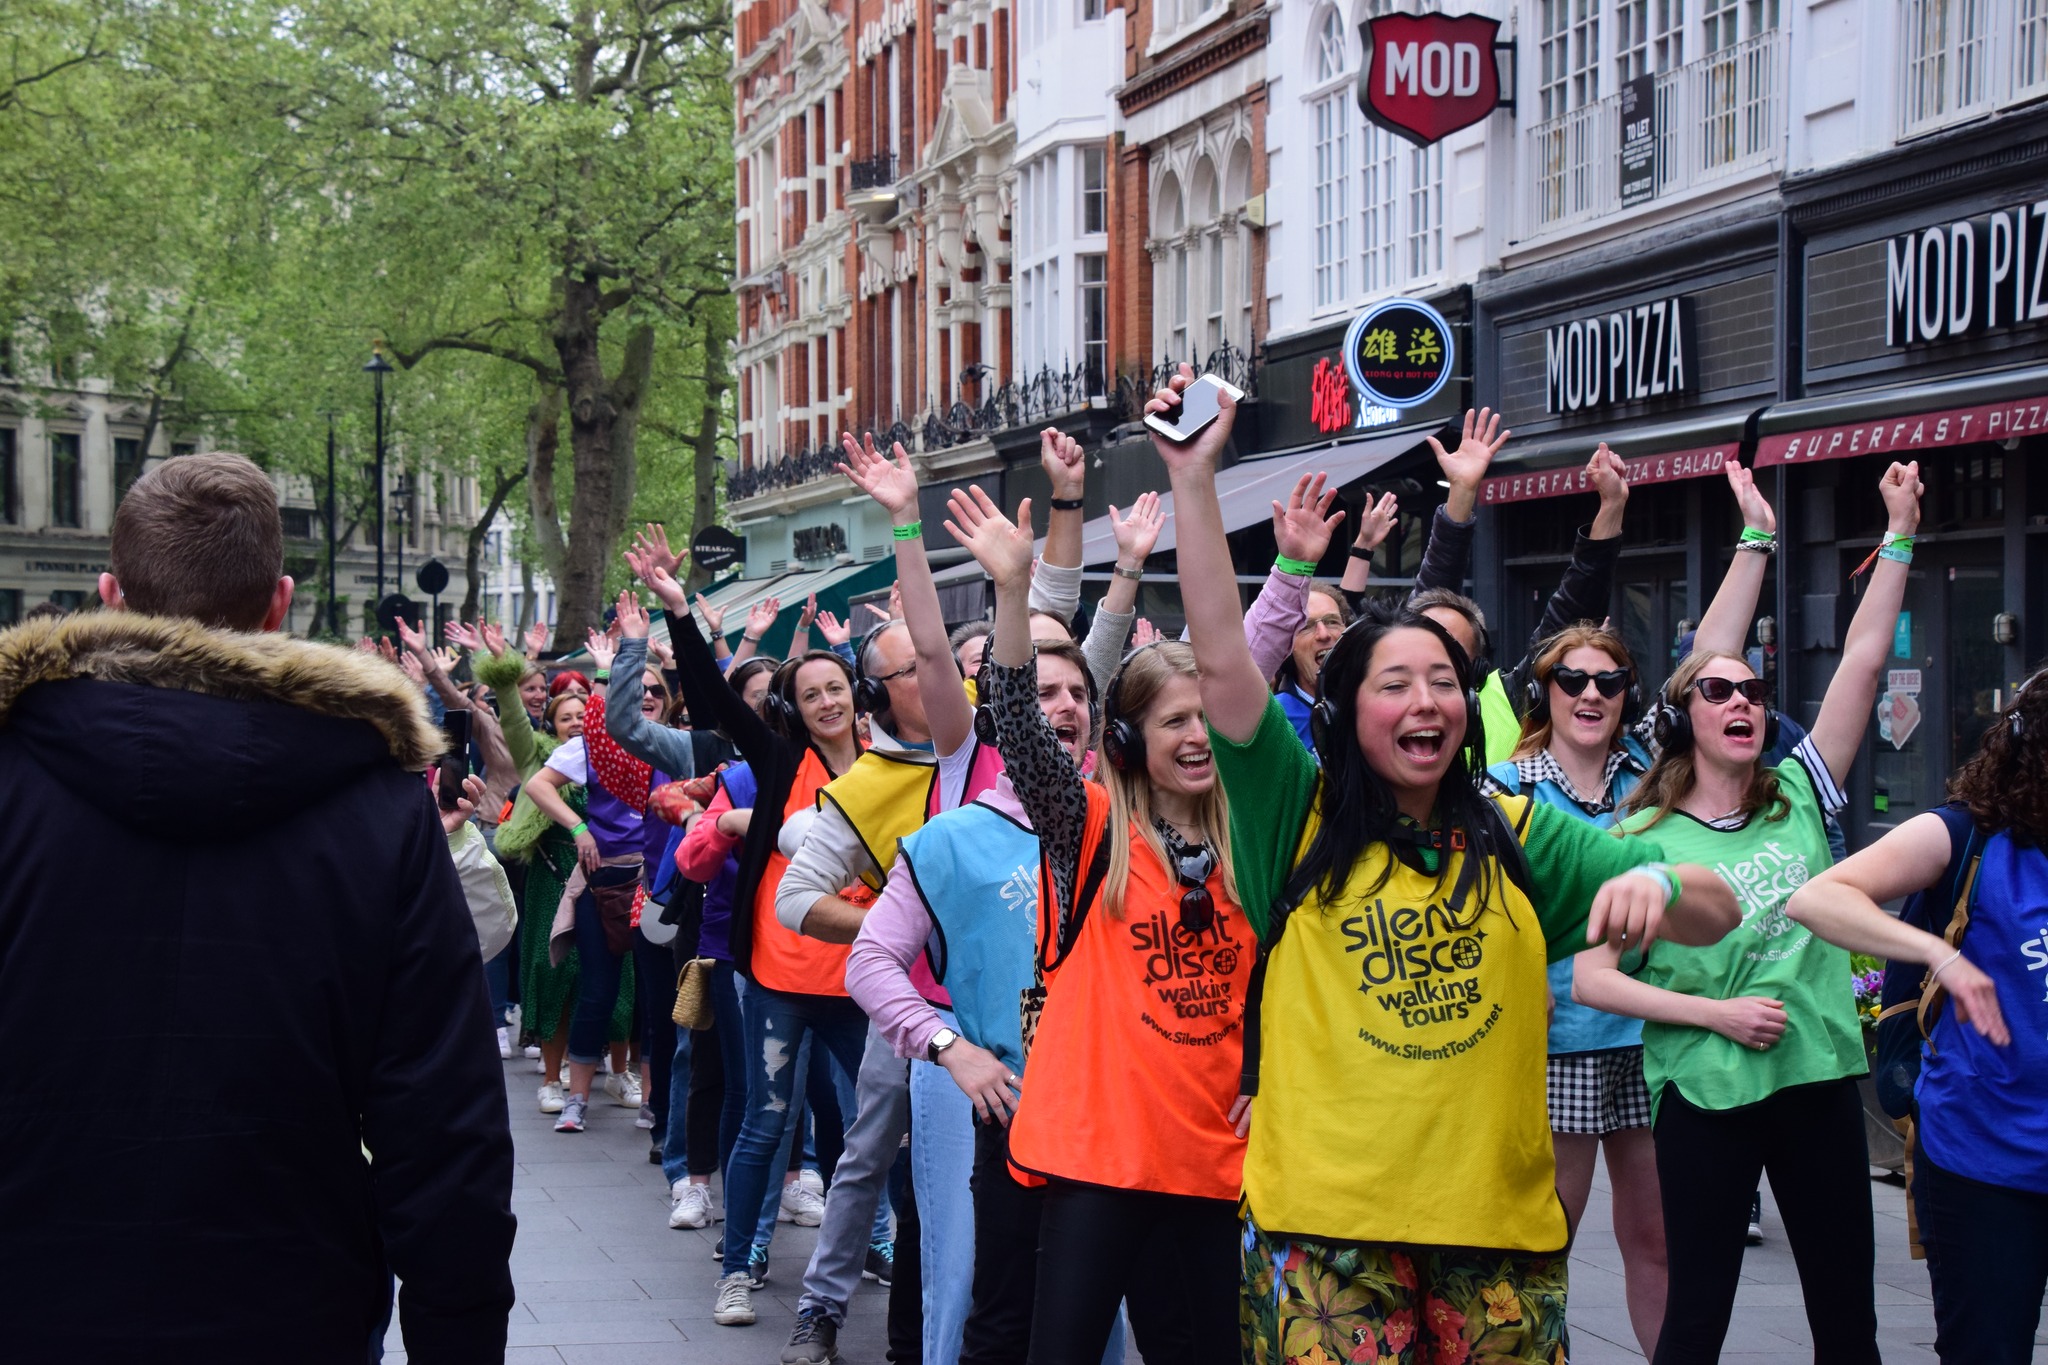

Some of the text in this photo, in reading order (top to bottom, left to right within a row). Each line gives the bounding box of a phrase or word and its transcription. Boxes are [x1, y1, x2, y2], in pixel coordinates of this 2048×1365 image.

[1385, 41, 1480, 97] MOD
[1626, 117, 1650, 141] TO LET
[1886, 198, 2048, 347] MOD PIZ
[1365, 370, 1438, 379] XIONG QI HOT POT
[1546, 297, 1685, 414] MOD PIZZA
[1784, 415, 1973, 460] SUPERFAST
[1485, 451, 1724, 501] SUPERFAS ZZA & SALAD
[1146, 946, 1238, 981] disco
[1362, 936, 1482, 985] disco
[1173, 999, 1230, 1019] tours
[1377, 976, 1482, 1012] walking
[1399, 1001, 1469, 1029] tours
[1357, 1002, 1503, 1061] www.SilentTours.net
